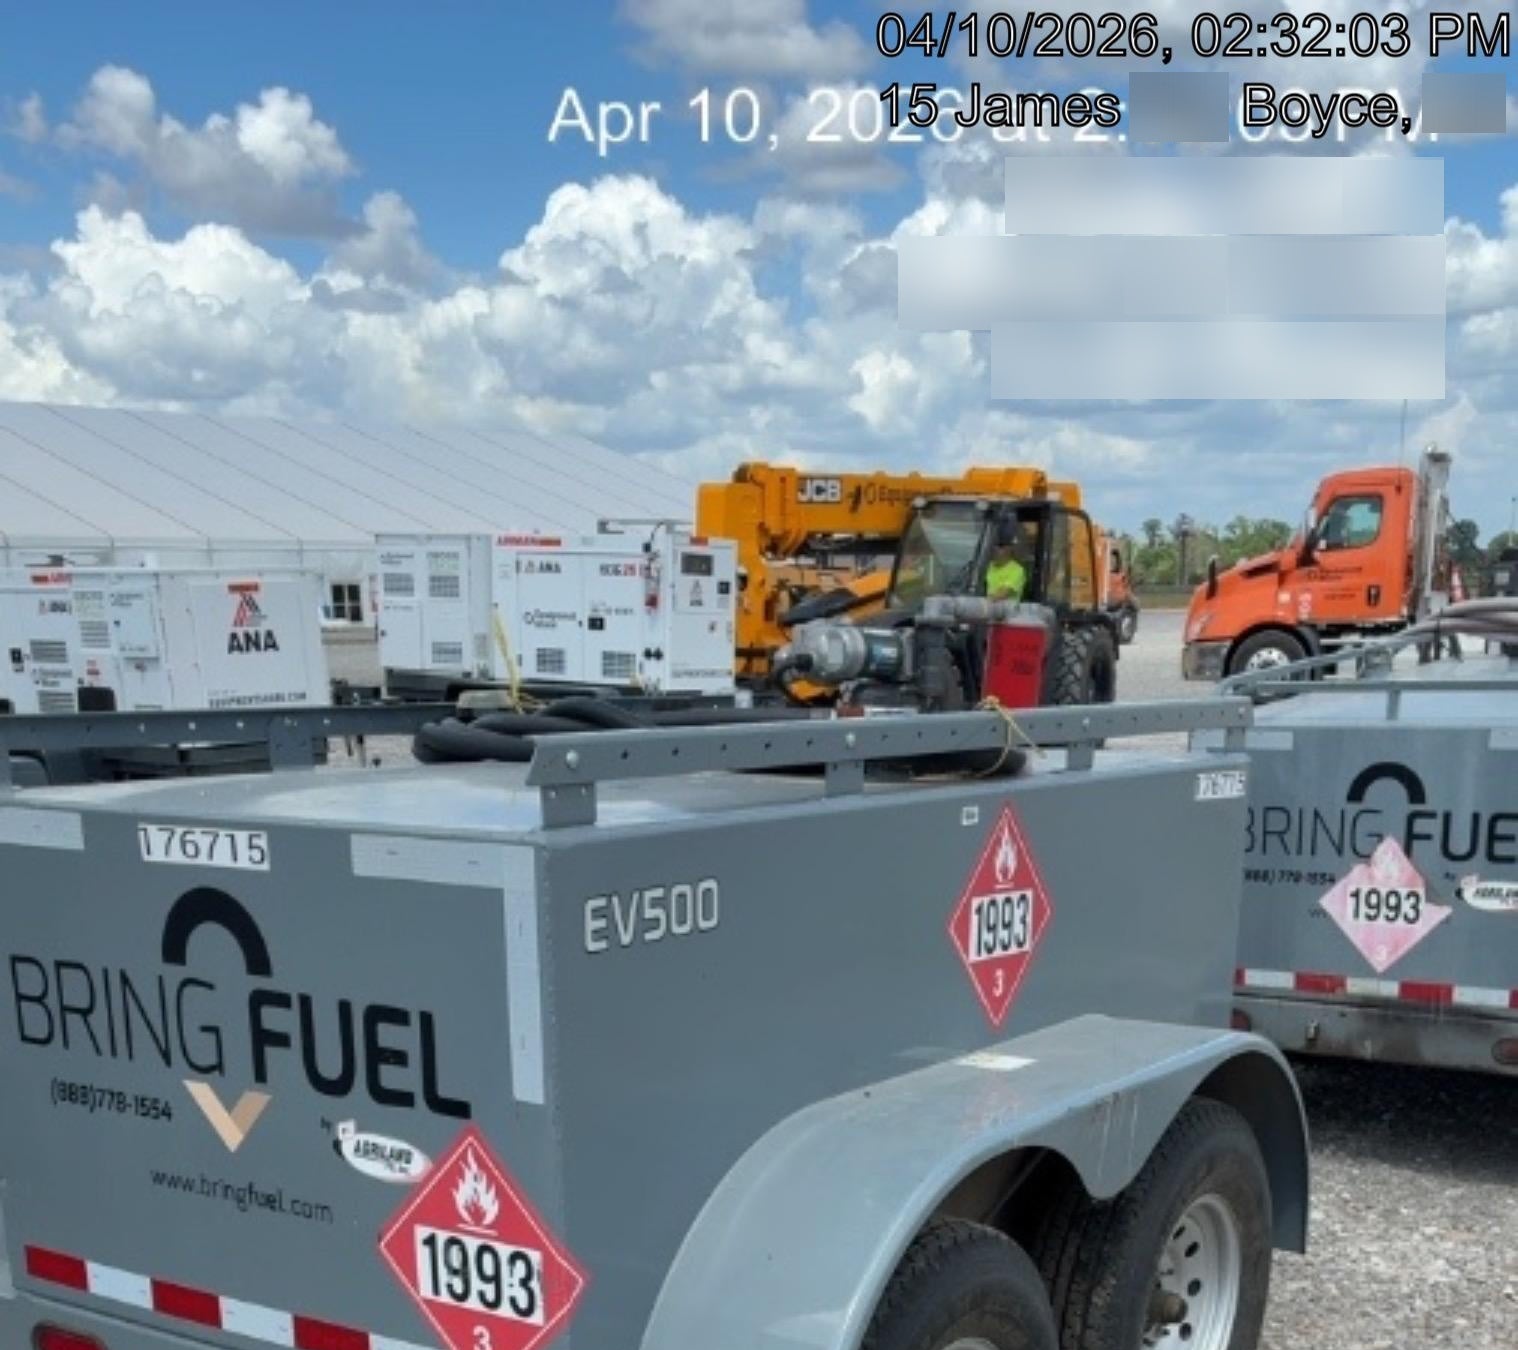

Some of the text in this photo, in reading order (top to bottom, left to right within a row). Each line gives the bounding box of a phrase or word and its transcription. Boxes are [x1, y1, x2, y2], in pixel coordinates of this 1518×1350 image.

[800, 480, 841, 502] JCB
[227, 629, 280, 655] ANA
[138, 827, 266, 865] 176715
[584, 877, 719, 952] EV500
[974, 893, 1029, 957] 1993
[1349, 888, 1421, 924] 1993
[992, 968, 1003, 997] 3
[9, 953, 472, 1120] BRING FUEL
[421, 1232, 537, 1318] 1993
